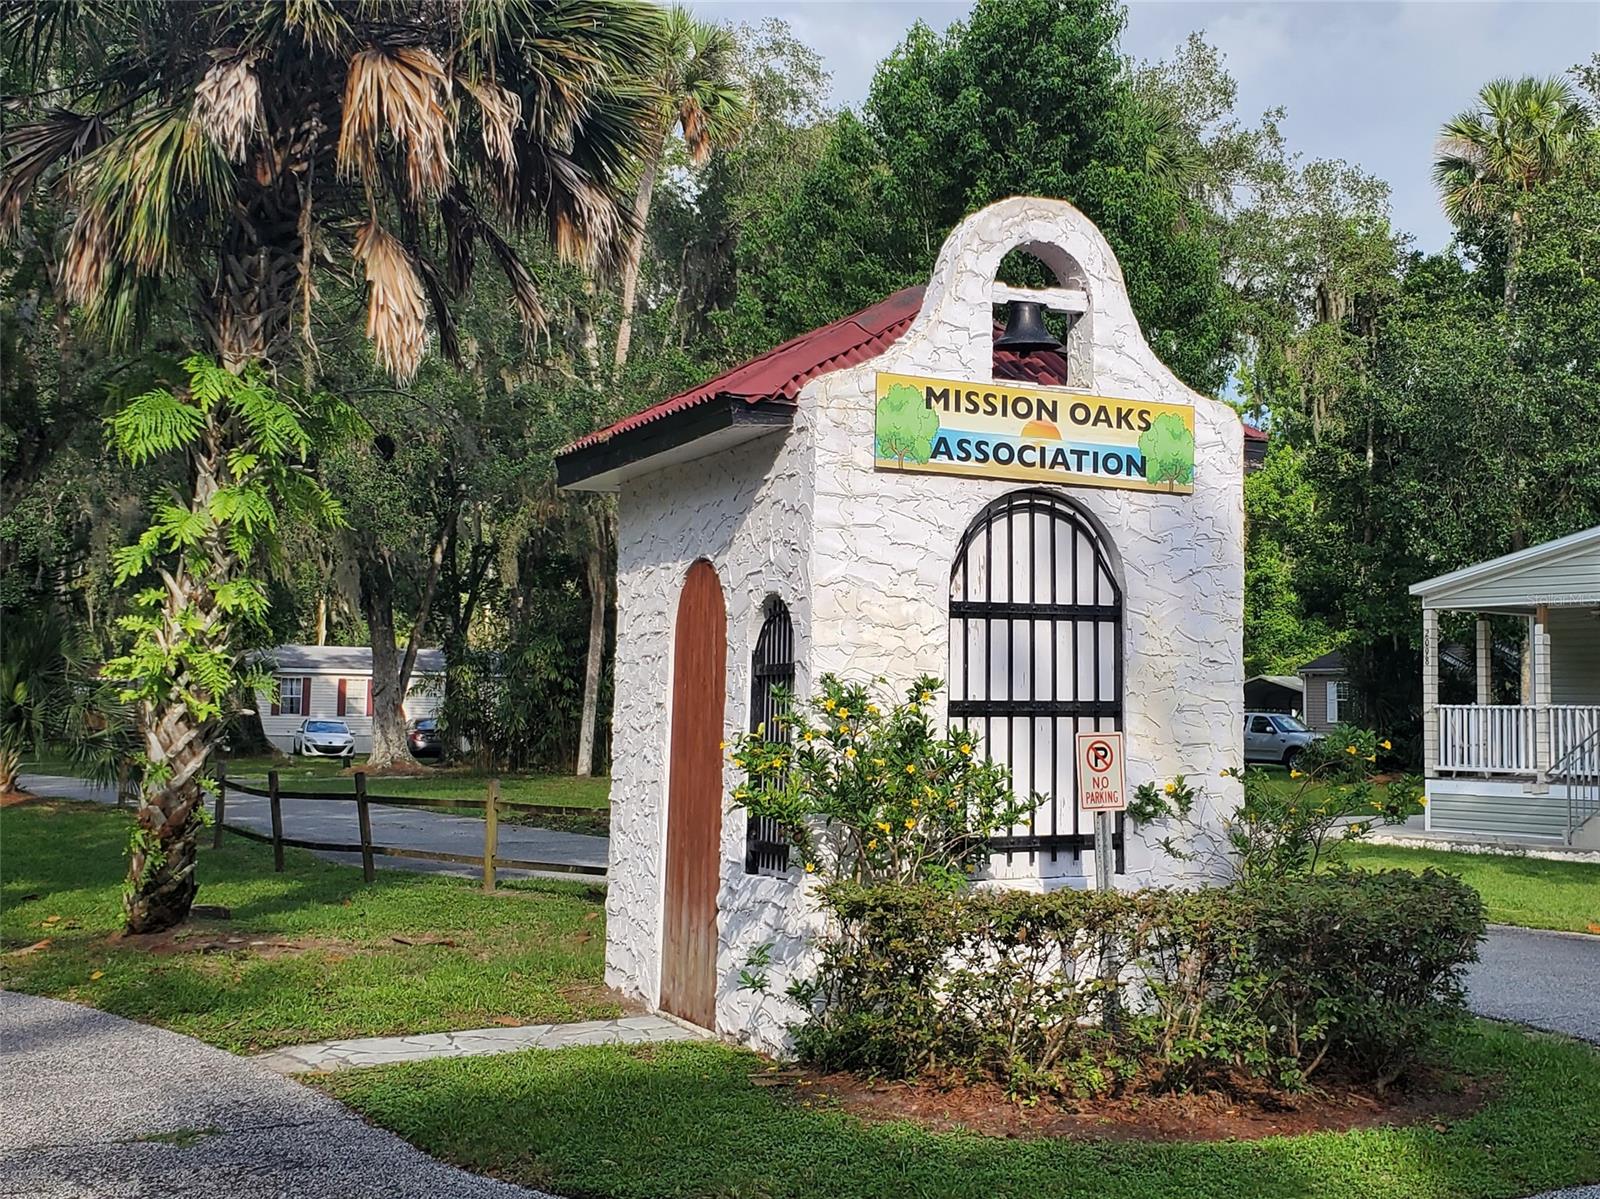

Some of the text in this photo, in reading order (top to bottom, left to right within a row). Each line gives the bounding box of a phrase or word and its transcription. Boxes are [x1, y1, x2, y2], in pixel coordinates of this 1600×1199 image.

[925, 386, 1152, 432] MISSION OAKS
[930, 436, 1147, 478] ASSOCIATION
[1092, 776, 1109, 789] NO
[1086, 791, 1119, 804] PARKING
